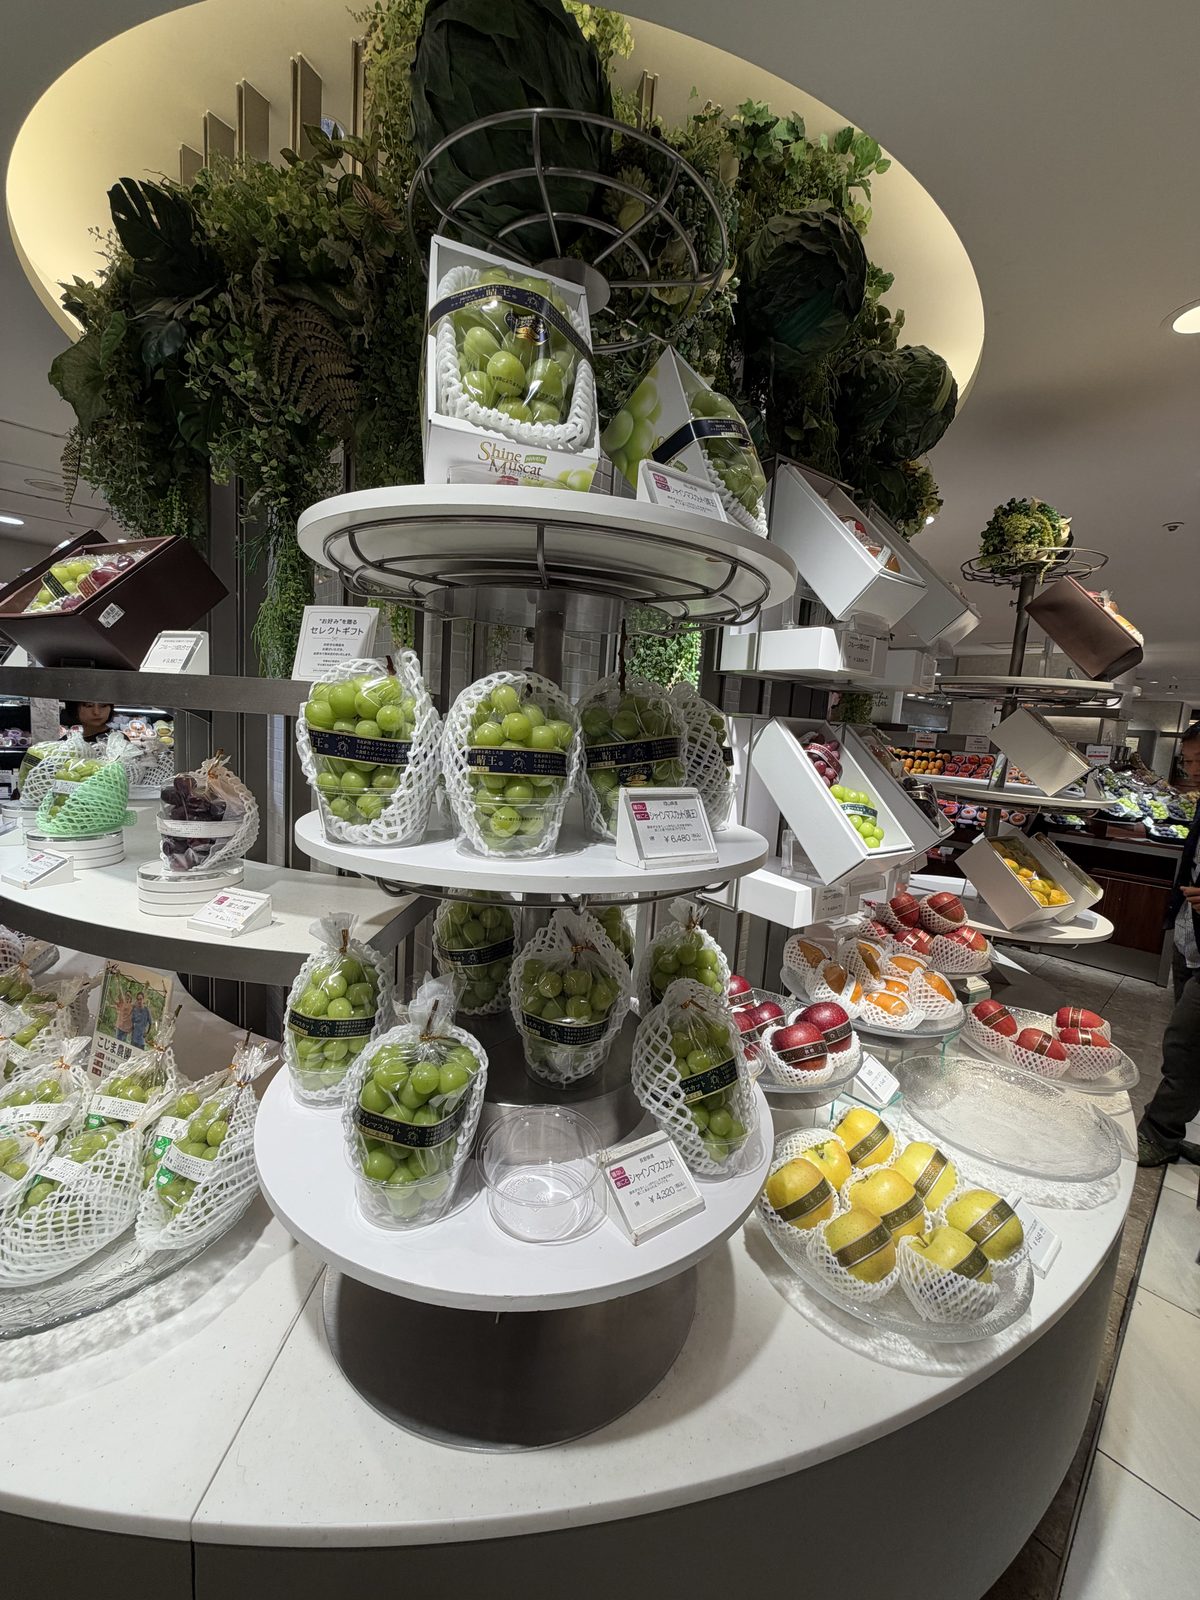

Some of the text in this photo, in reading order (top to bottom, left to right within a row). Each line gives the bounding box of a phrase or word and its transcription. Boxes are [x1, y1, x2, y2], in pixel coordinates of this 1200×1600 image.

[478, 441, 522, 462] Shine
[488, 459, 543, 476] Muscat
[311, 626, 364, 636] セレクトギフト
[476, 754, 498, 766] 晴王
[97, 1036, 132, 1060] こじま農園
[628, 1156, 675, 1184] シャインマスカット
